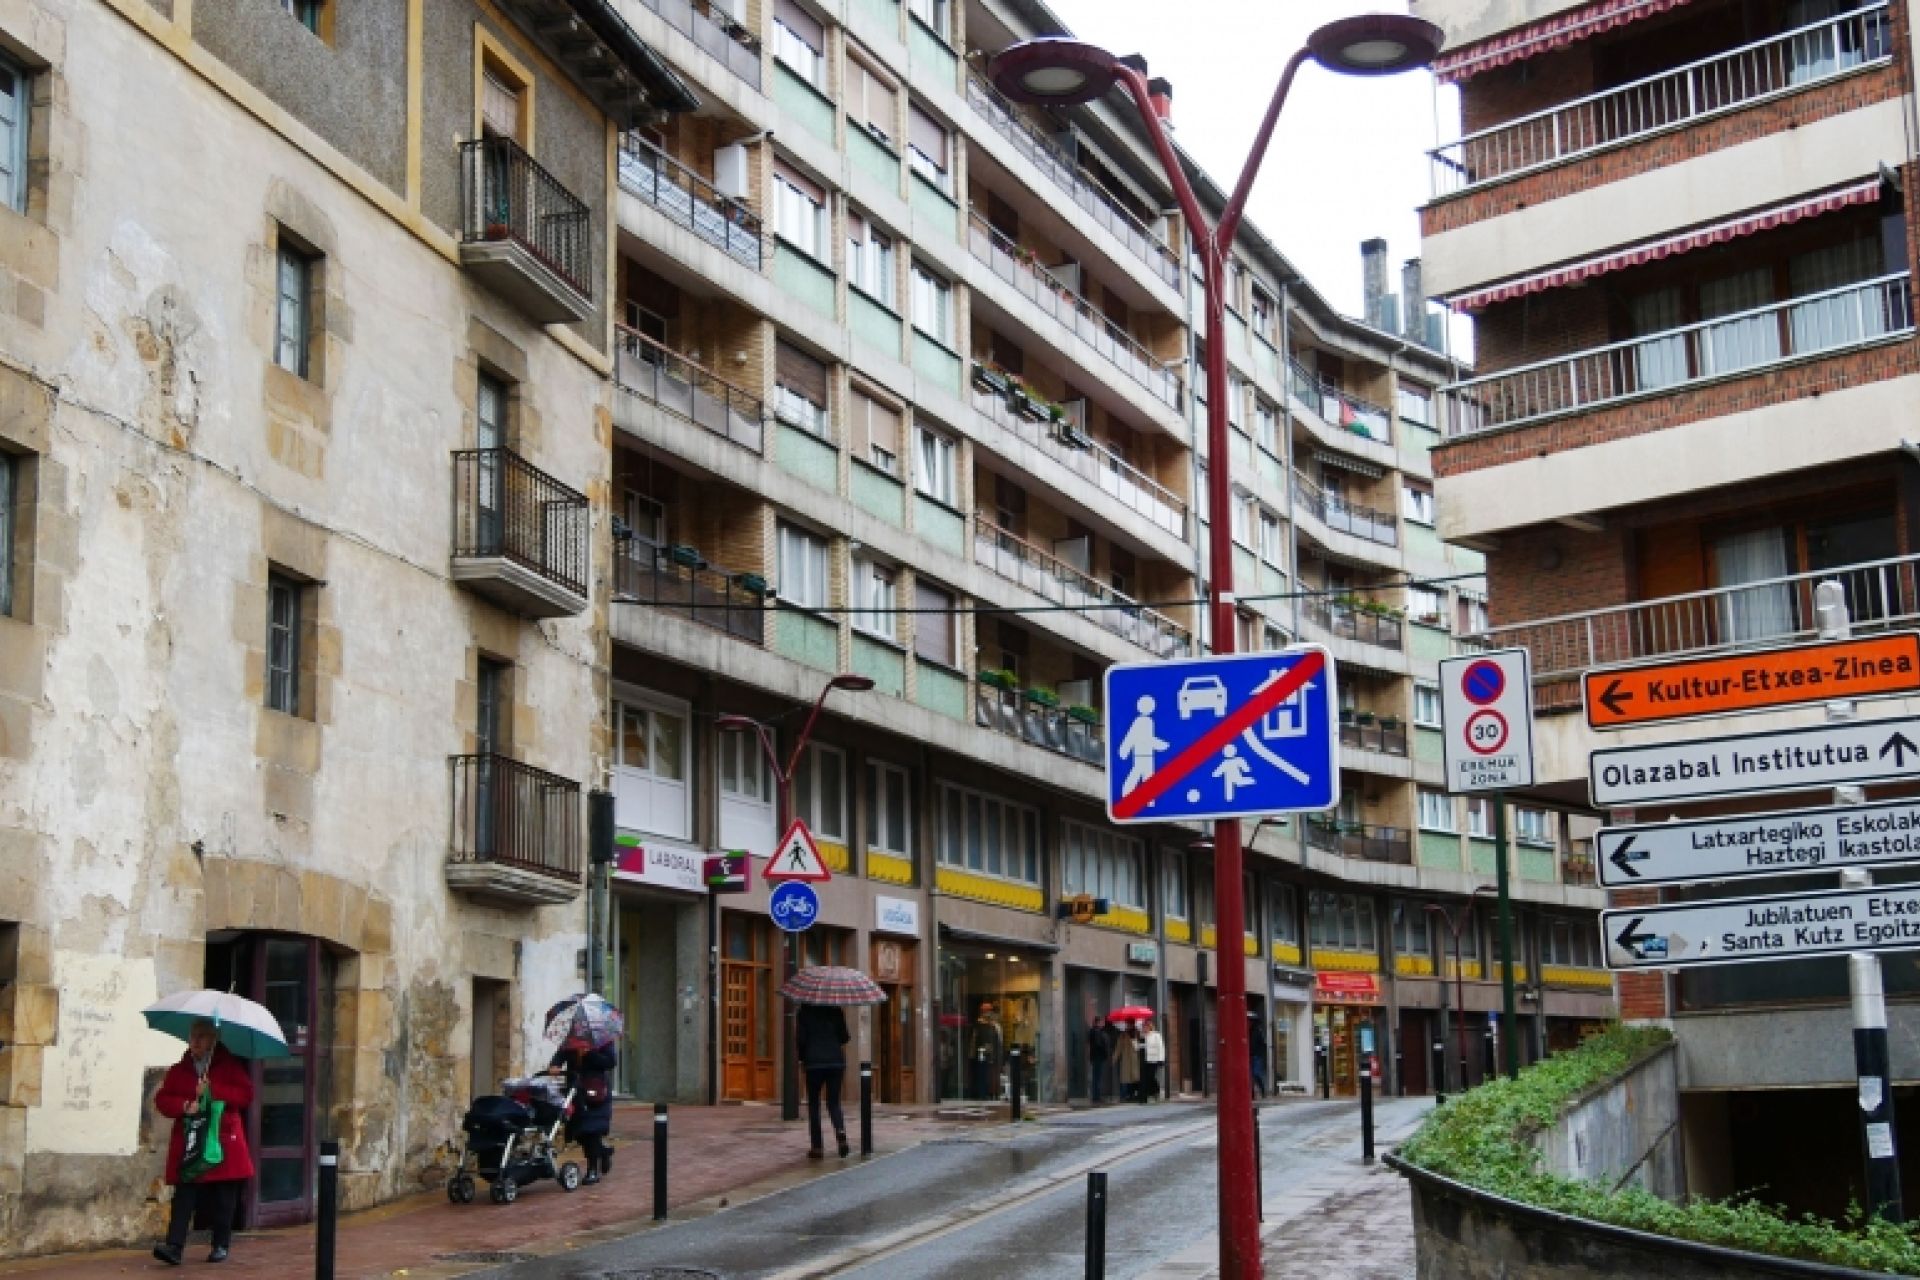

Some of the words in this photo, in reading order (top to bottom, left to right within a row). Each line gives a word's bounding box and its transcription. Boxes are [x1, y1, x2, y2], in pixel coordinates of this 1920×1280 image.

[1648, 655, 1912, 702] Kultur-Etxea-Zinea
[1475, 724, 1499, 740] 30
[1603, 754, 1721, 787] Olazabal
[1733, 744, 1869, 774] Institutua
[1692, 821, 1823, 849] Latxartegiko
[1837, 810, 1920, 836] Eskolak
[649, 849, 697, 875] LABORAL
[1747, 841, 1826, 865] Haztegi
[1745, 904, 1853, 927] Jubilatuen
[1721, 930, 1784, 952] Santa
